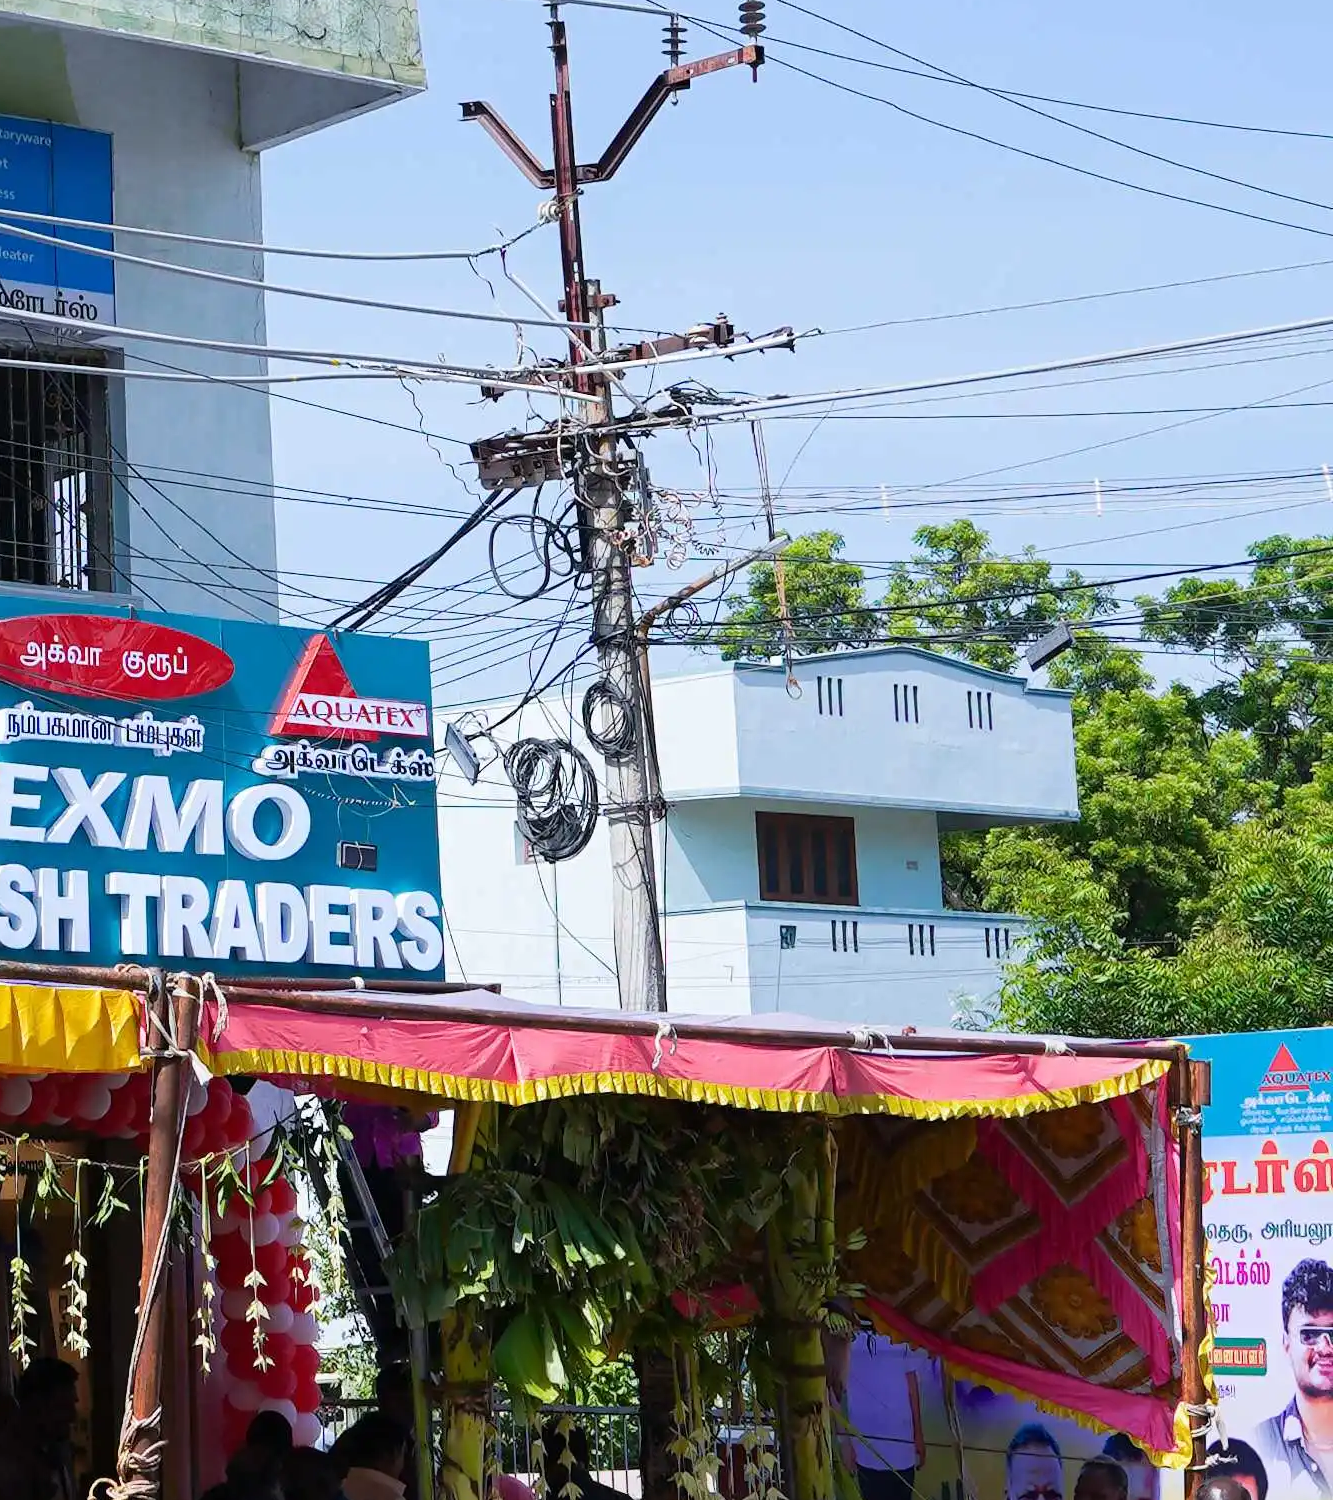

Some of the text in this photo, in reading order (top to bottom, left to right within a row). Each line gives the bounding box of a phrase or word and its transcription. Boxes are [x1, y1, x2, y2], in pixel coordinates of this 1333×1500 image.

[20, 634, 187, 680] அக்வா குரூப்
[7, 706, 113, 740] நம்பகமான
[293, 699, 414, 727] AQUATEX
[105, 872, 445, 971] TRADERS
[1262, 1070, 1332, 1085] AQUATEX
